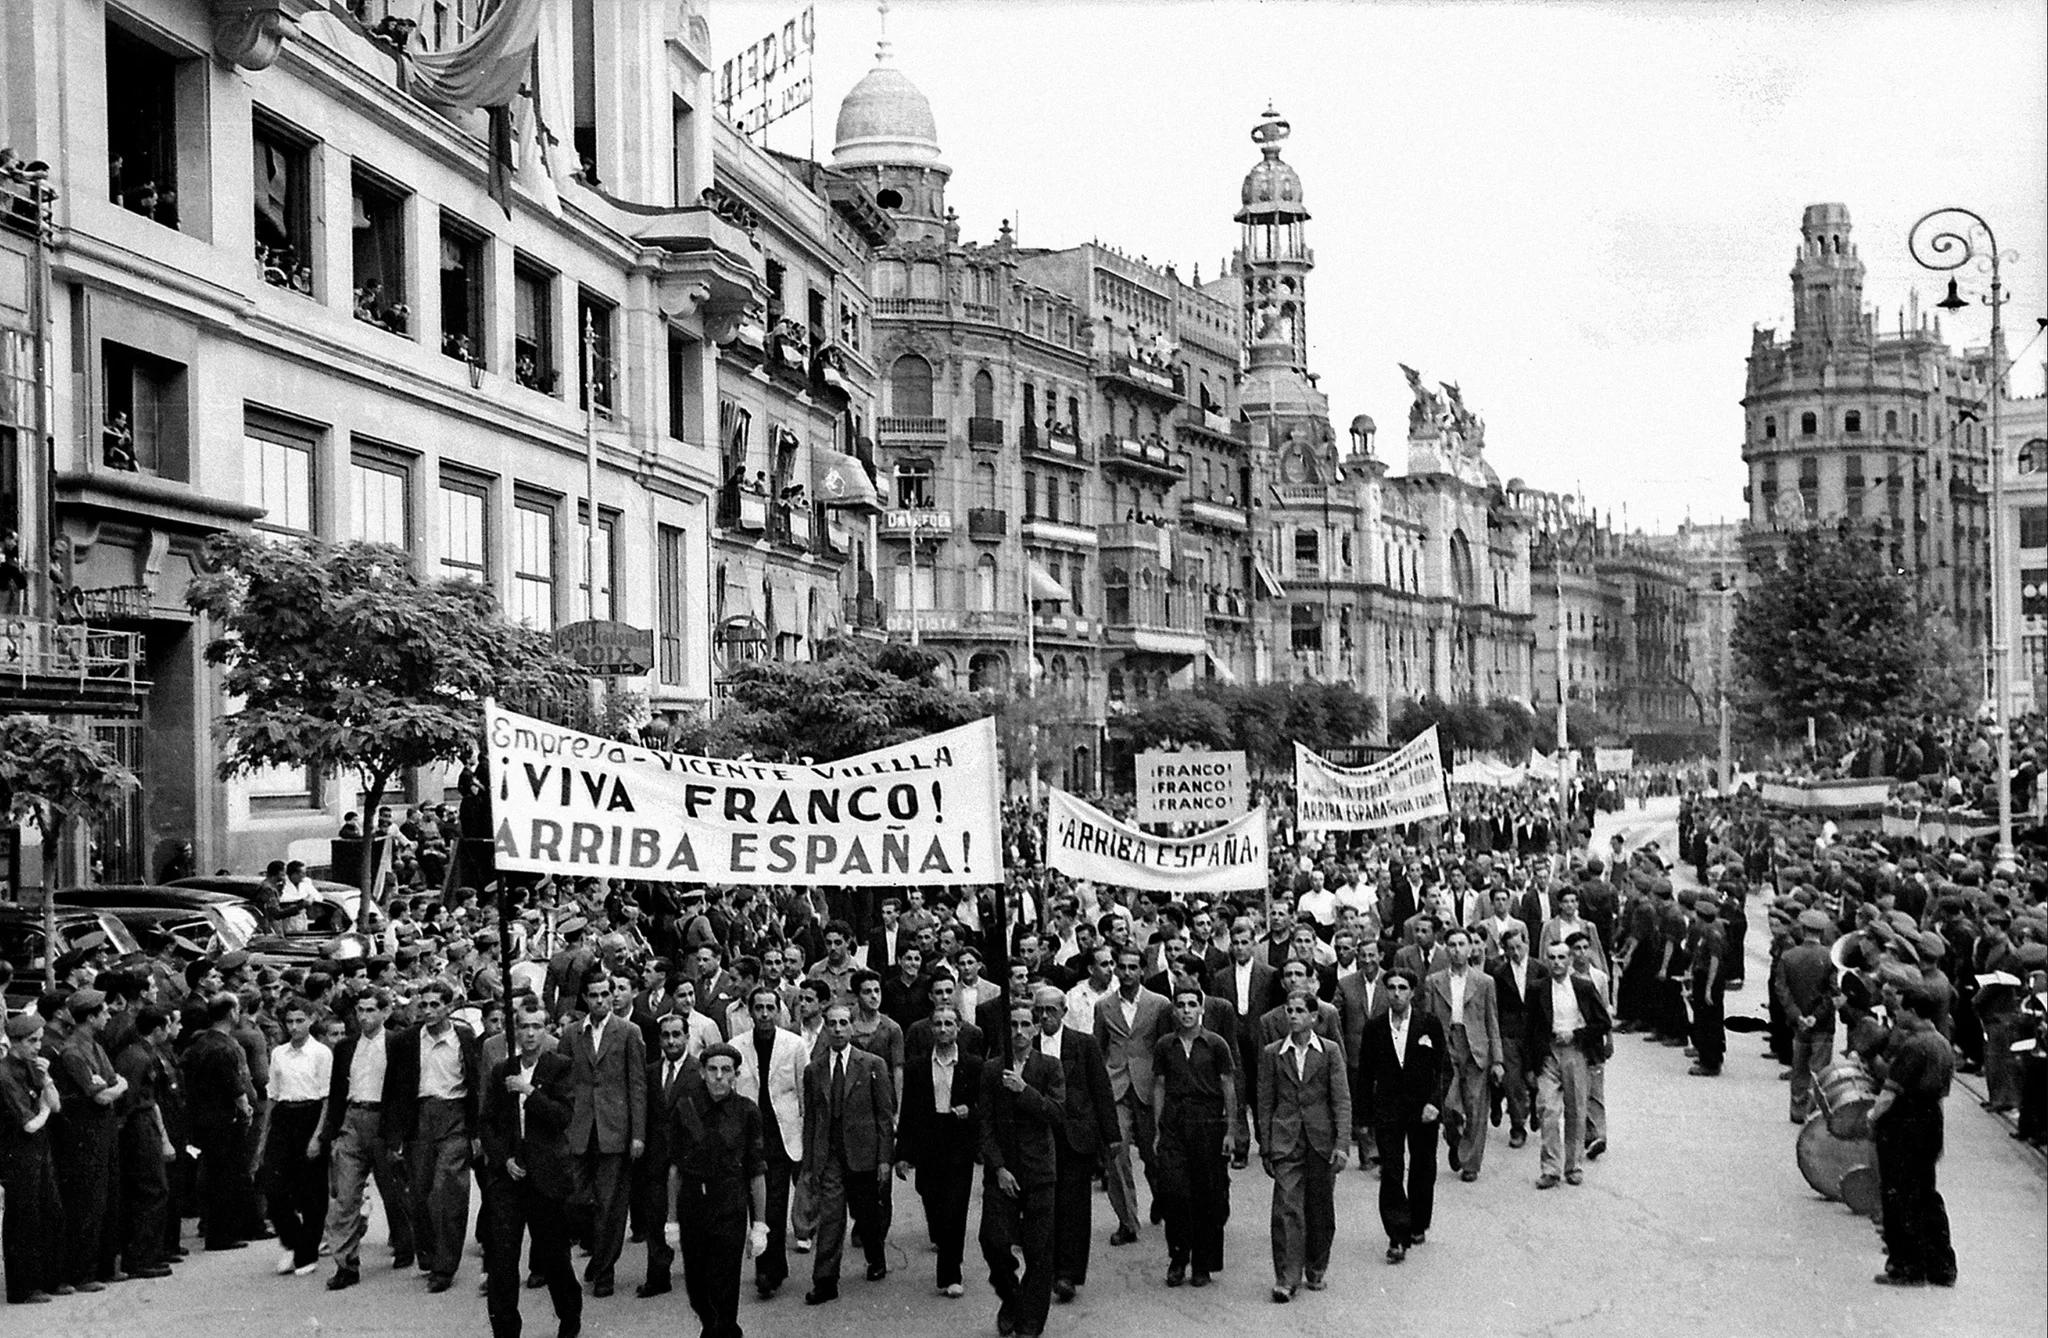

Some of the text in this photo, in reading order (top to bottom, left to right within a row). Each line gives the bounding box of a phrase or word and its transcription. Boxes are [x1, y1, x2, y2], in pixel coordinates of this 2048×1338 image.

[651, 751, 793, 781] VICENTE
[1151, 763, 1232, 777] ¡FRANCO!
[498, 757, 944, 824] ¡VIVA FRANCO!
[1152, 780, 1233, 794] ¡FRANCO!
[1152, 797, 1234, 811] ¡FRANCO!
[495, 817, 972, 874] ARRIBA ESPAÑA!
[1059, 815, 1259, 869] ¡ARRIBA ESPAÑA!
